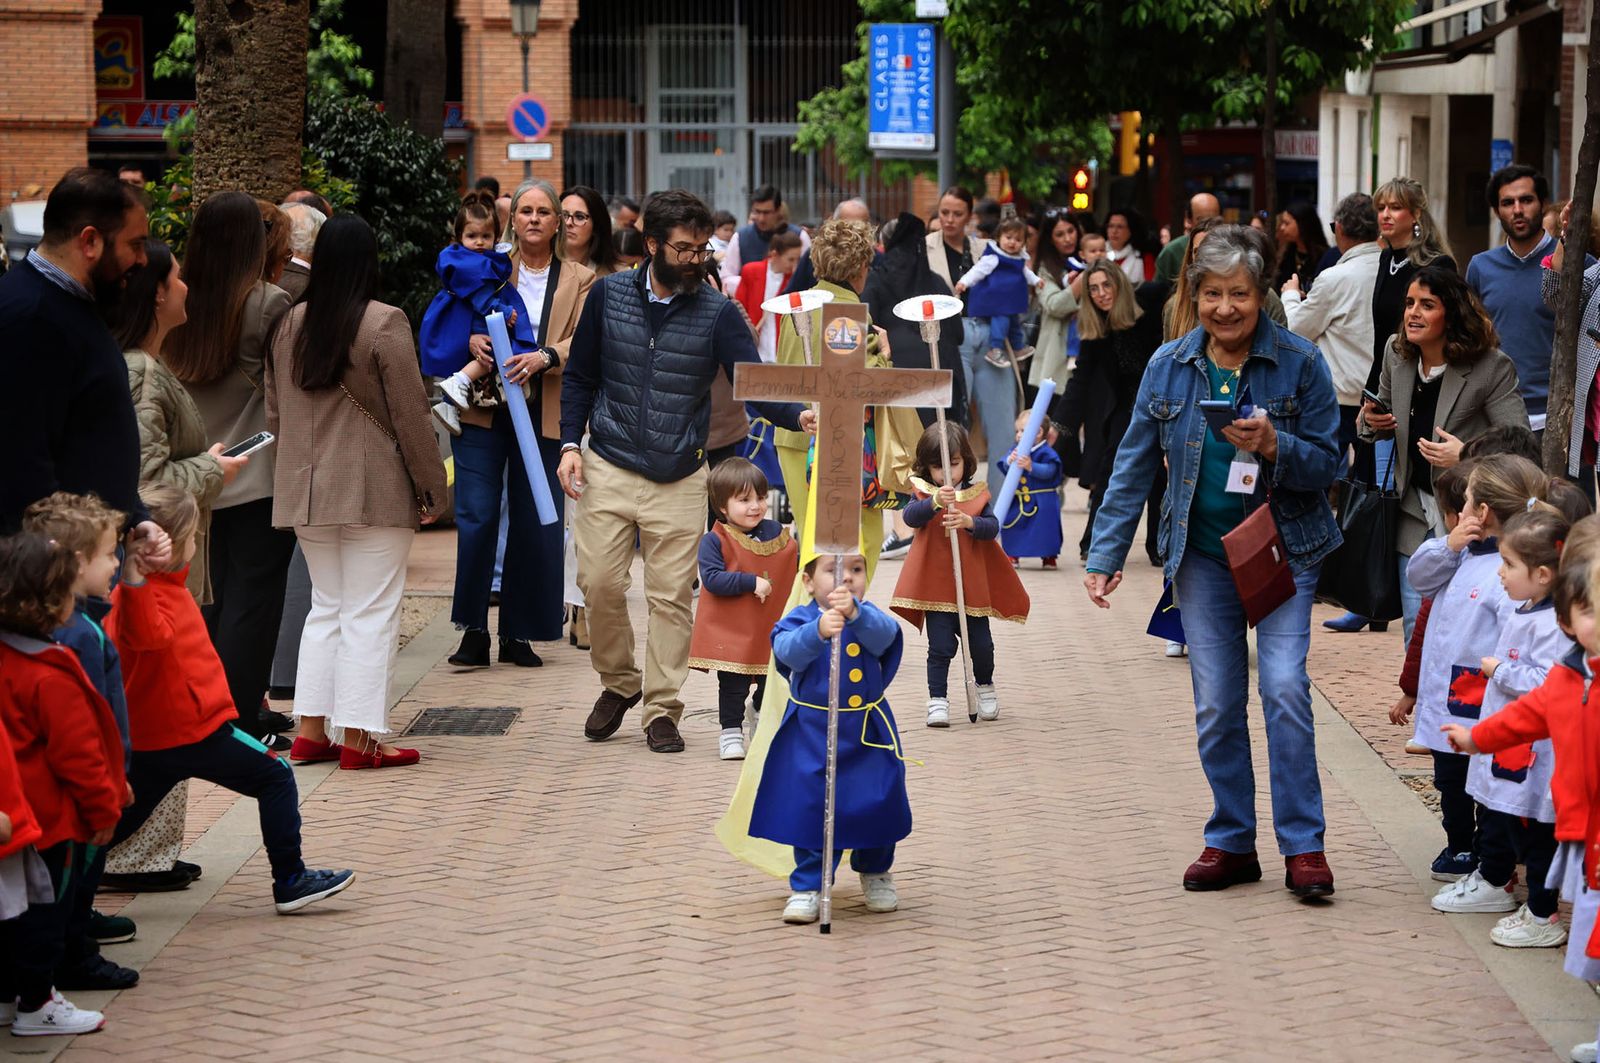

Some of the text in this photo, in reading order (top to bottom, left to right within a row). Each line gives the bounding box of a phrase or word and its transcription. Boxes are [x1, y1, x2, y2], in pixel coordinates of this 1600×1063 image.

[875, 34, 888, 112] CLASES
[737, 367, 818, 396] Hermandad
[829, 404, 847, 473] CRUZ
[821, 476, 854, 488] DE
